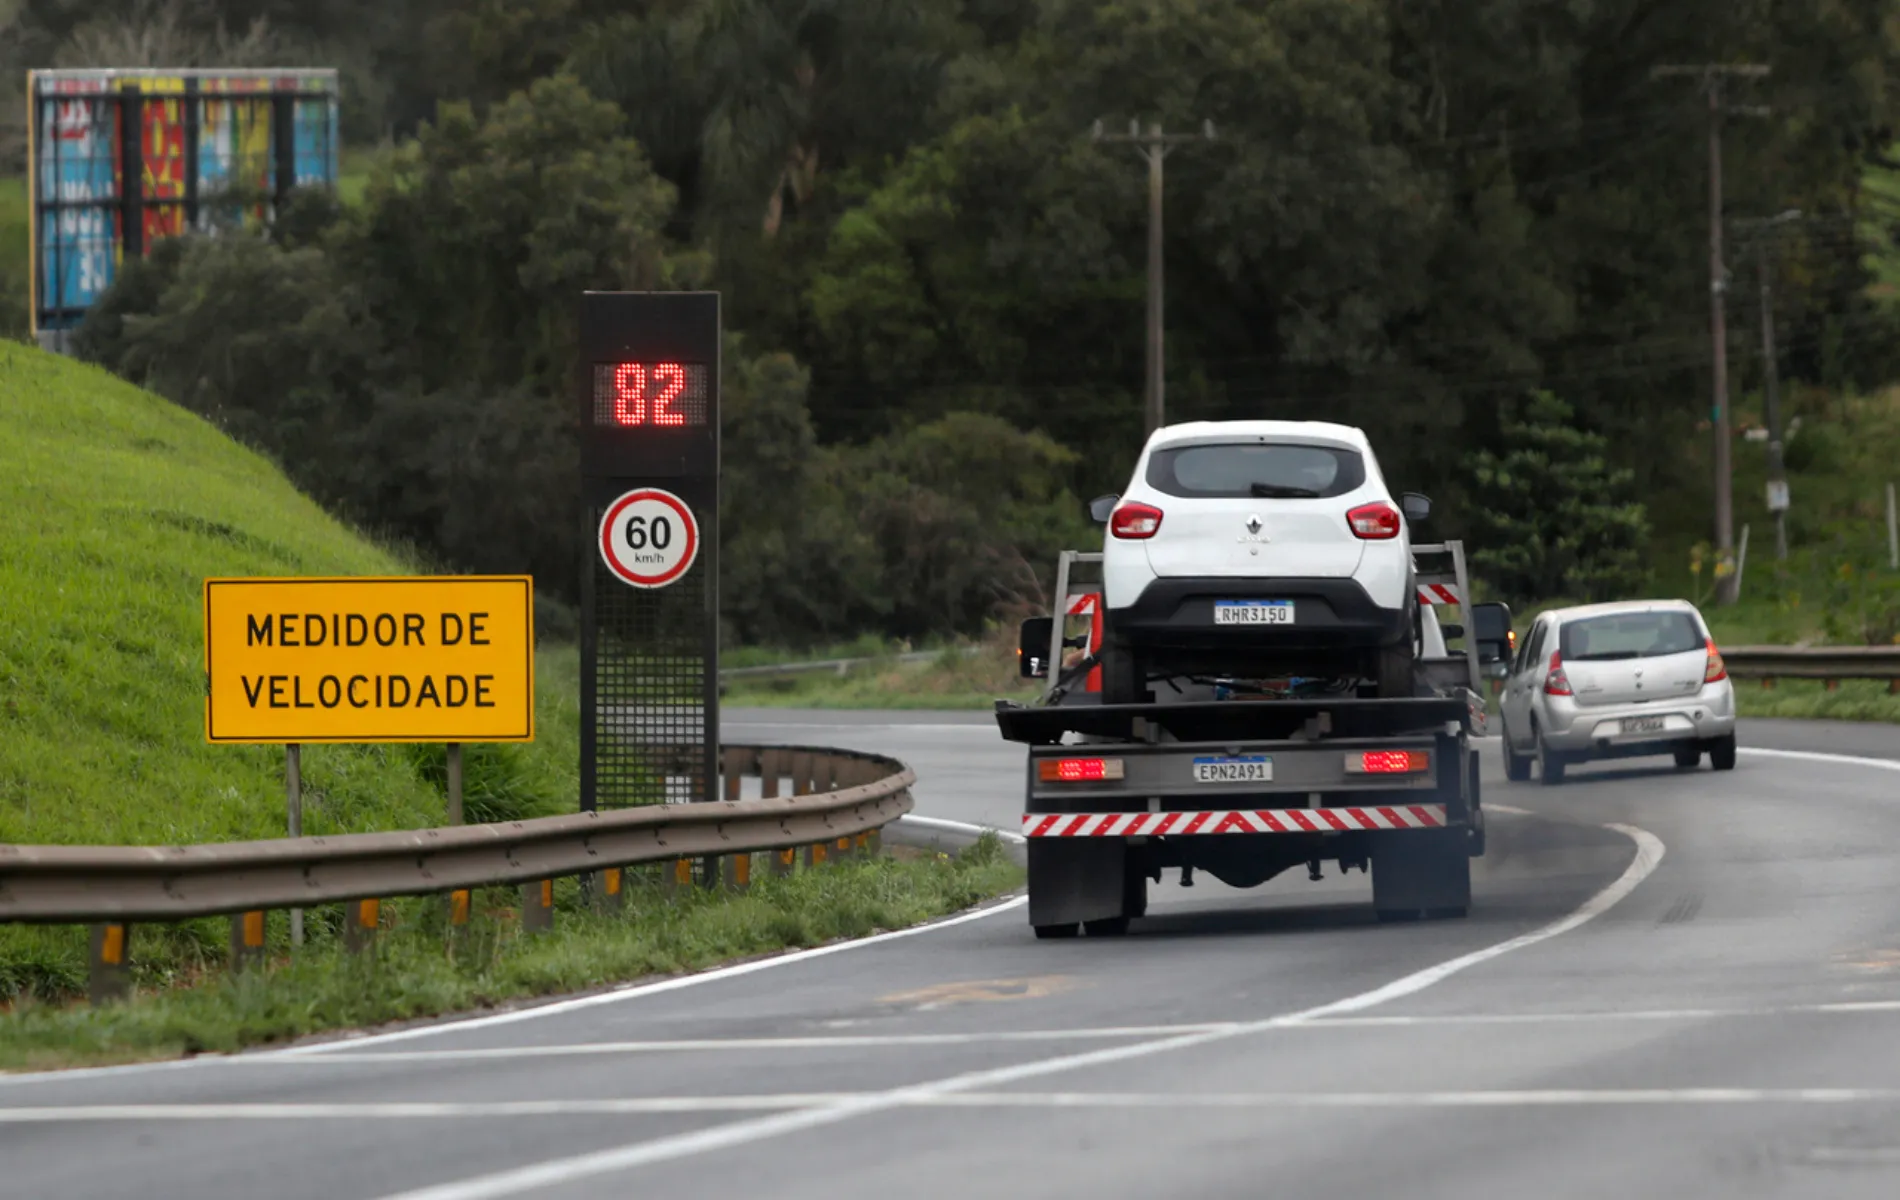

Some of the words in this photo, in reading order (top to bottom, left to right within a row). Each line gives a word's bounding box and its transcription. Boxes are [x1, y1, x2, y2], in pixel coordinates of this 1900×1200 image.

[614, 362, 686, 426] 82
[625, 516, 671, 549] 60
[634, 553, 666, 564] km/h
[247, 613, 425, 646] MEDIDOR
[440, 612, 491, 645] DE
[240, 674, 496, 708] VELOCIDADE
[1200, 764, 1264, 780] EPN2A91
